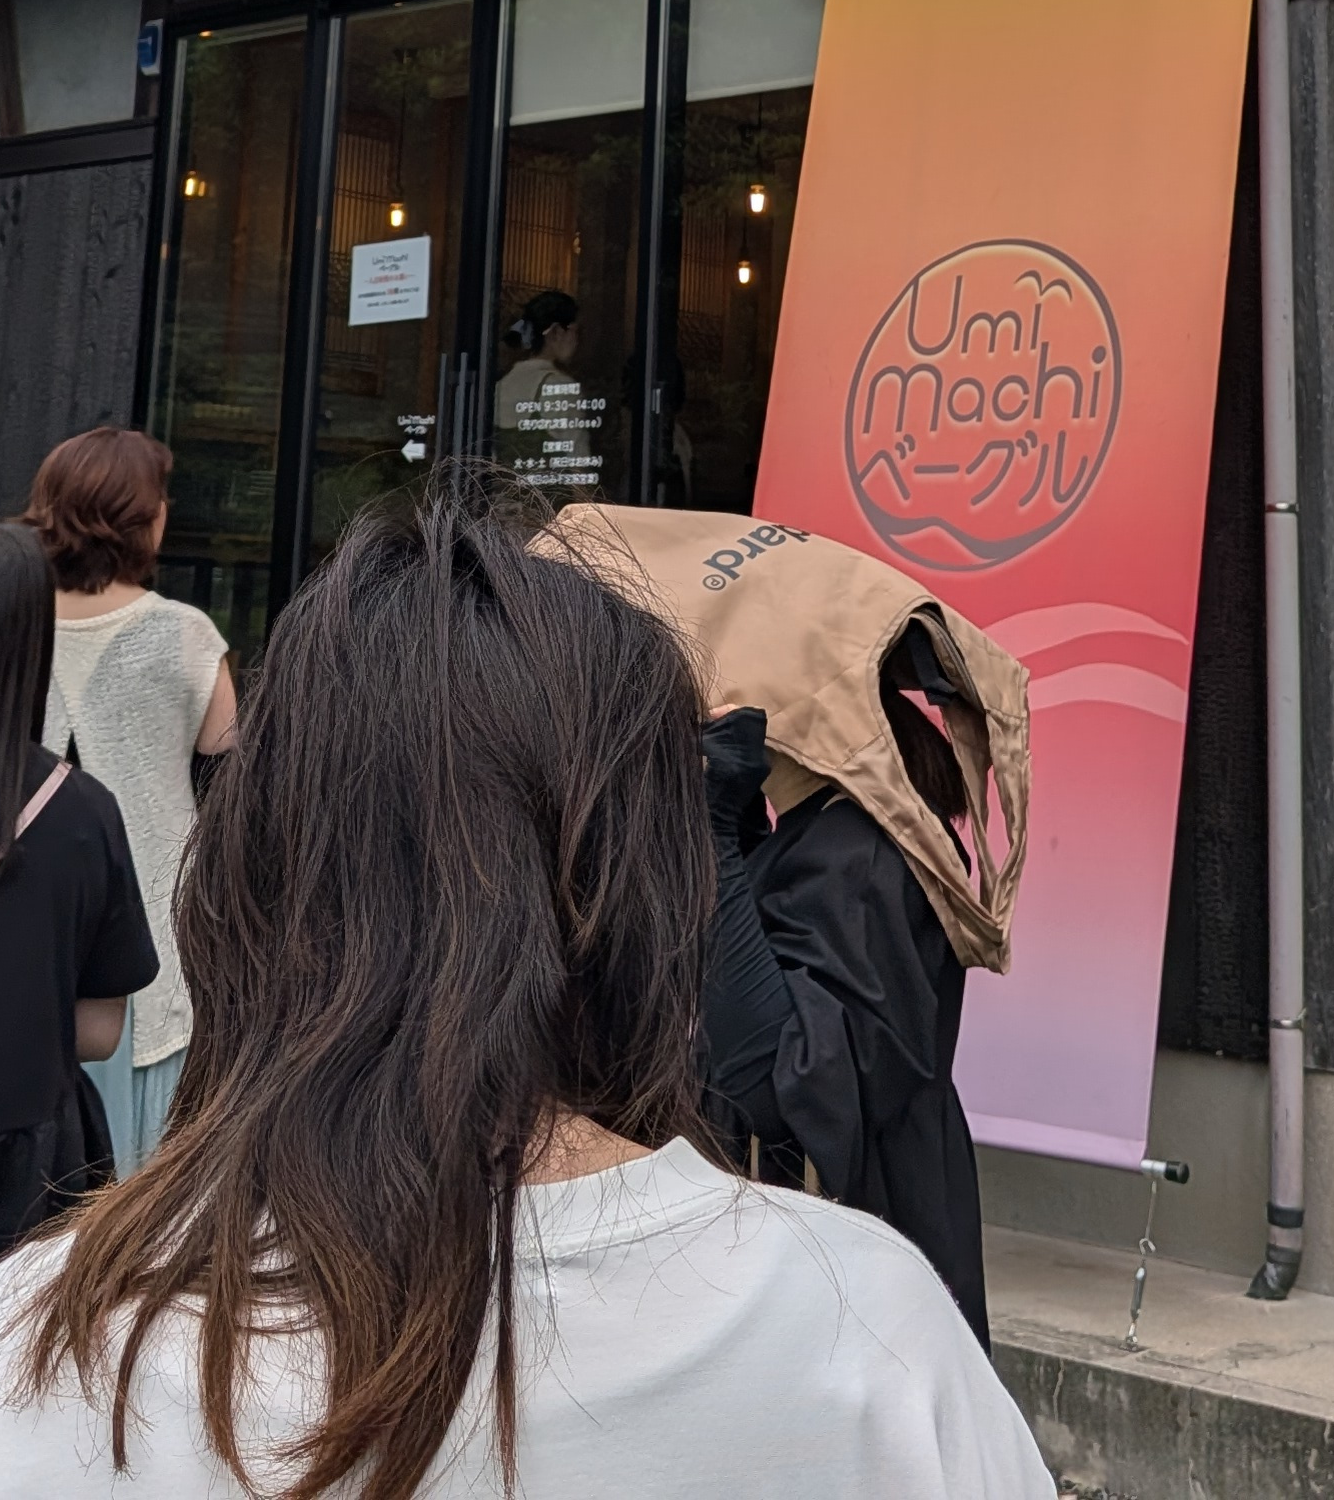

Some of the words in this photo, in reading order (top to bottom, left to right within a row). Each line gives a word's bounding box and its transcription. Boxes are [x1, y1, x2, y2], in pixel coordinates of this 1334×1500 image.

[907, 270, 1073, 356] Umi
[515, 401, 542, 413] OPEN
[862, 341, 1108, 434] machi
[857, 429, 1089, 507] ベーグル
